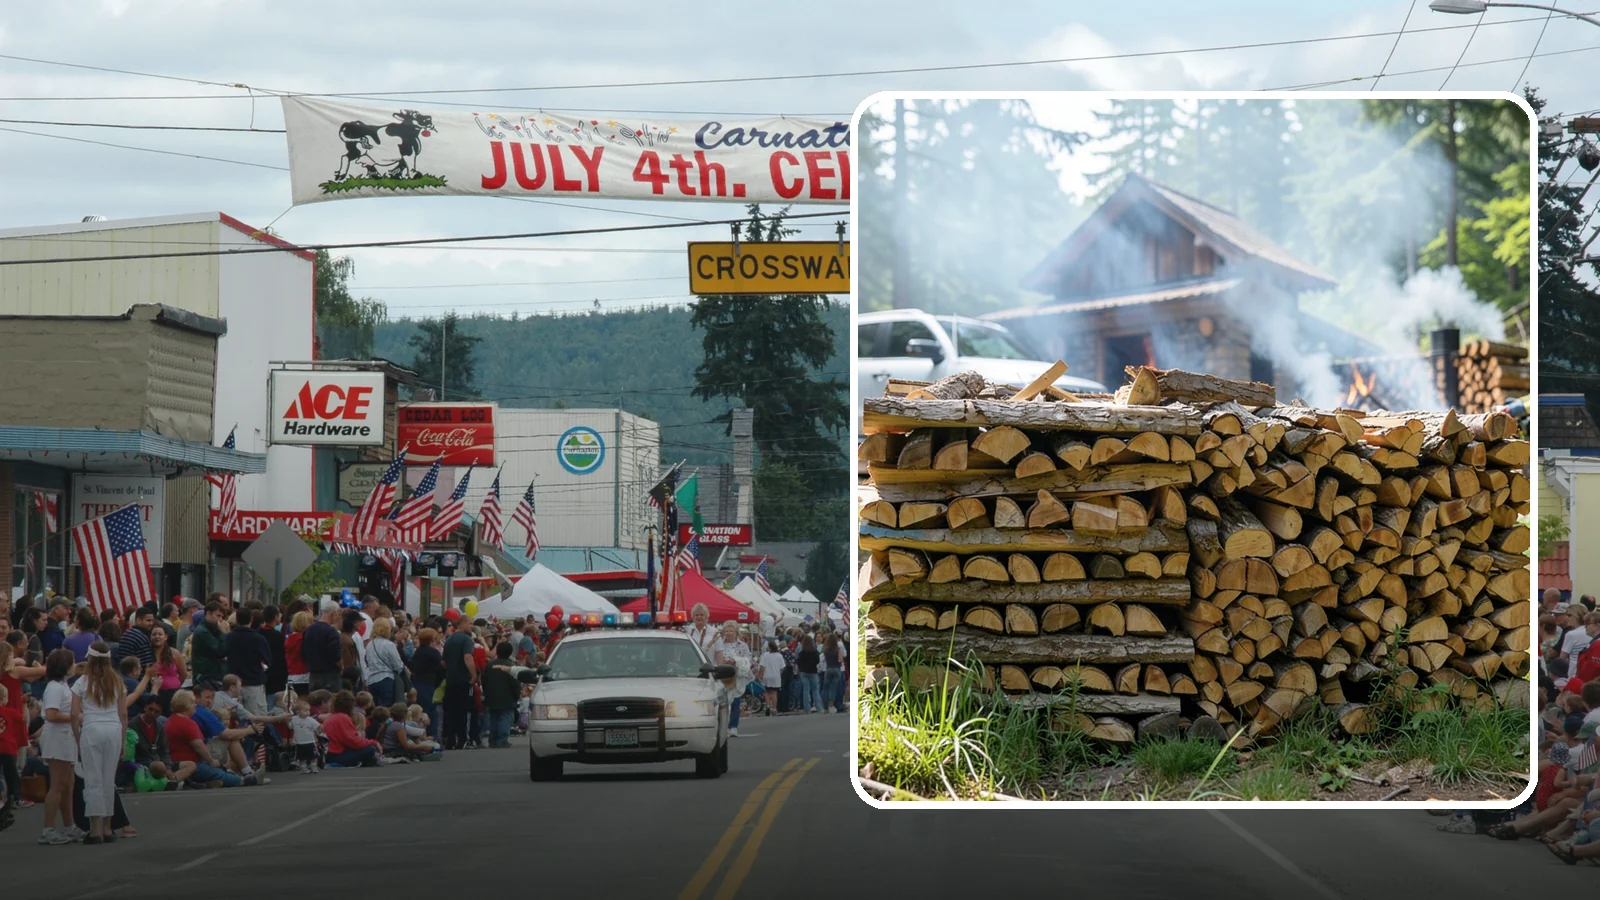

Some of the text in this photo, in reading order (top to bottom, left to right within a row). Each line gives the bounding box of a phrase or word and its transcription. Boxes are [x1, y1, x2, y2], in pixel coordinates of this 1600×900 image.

[481, 141, 604, 192] JULY
[632, 150, 746, 198] 4th.
[697, 254, 850, 280] CROSSWA
[282, 380, 373, 420] ACE
[405, 409, 485, 422] CEDAR LOG
[283, 421, 371, 436] Hardware
[416, 428, 477, 447] Coca-Cola
[83, 485, 155, 495] St. Vincent de Paul
[699, 535, 730, 543] GLASS
